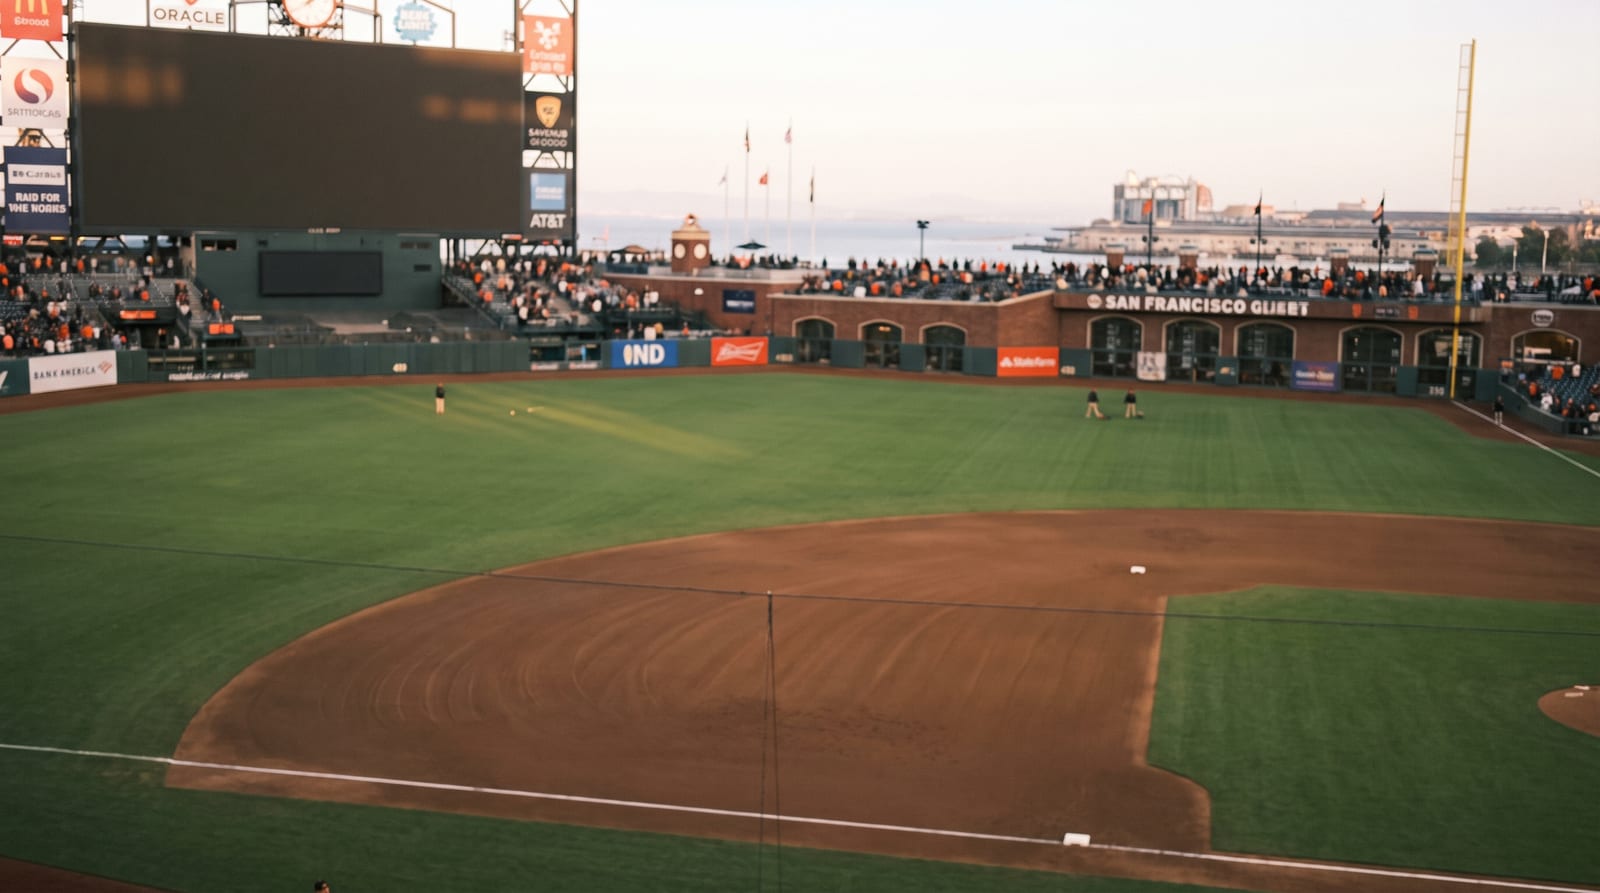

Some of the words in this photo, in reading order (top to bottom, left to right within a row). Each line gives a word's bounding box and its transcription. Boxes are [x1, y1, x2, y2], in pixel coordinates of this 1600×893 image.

[154, 8, 224, 24] ORACLE
[40, 193, 60, 203] FOR
[530, 213, 566, 229] AT&T
[1105, 294, 1140, 310] SAN
[1144, 296, 1247, 314] FRANCISCO
[33, 370, 58, 380] BANK
